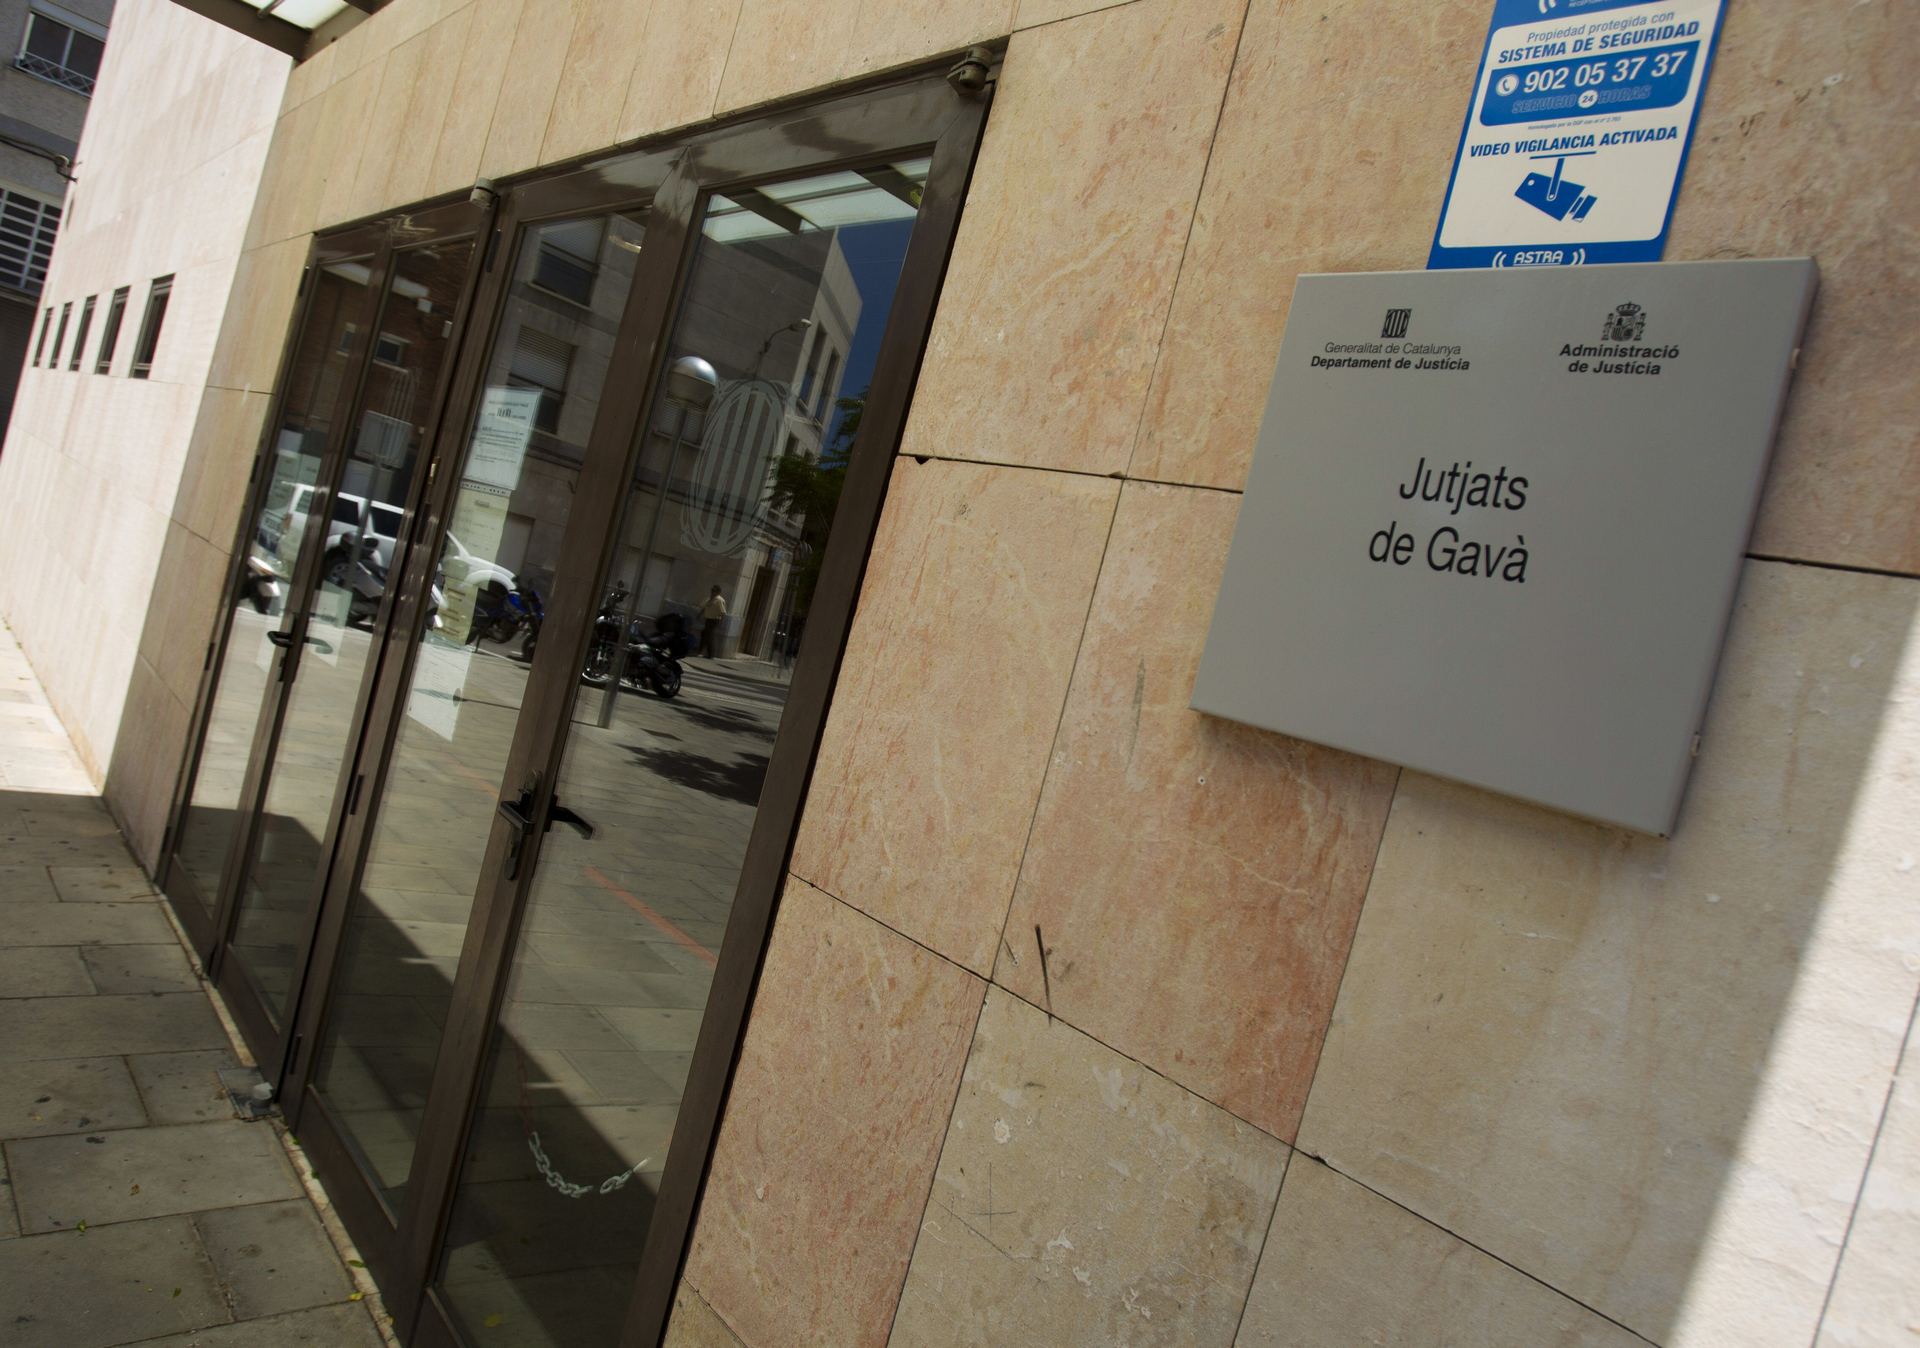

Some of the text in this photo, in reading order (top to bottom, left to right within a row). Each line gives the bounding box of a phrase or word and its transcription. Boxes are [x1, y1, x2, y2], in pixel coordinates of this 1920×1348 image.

[1498, 21, 1700, 63] SISTEMA DE SEGURIDAD
[1527, 12, 1674, 43] Propiedad protegida con
[1523, 50, 1688, 93] 902 05 37 37
[1470, 126, 1678, 157] VIDEO VIGILANCIA ACTIVADA
[1513, 250, 1564, 264] ASTRA
[1311, 356, 1470, 370] Departament de Justícia
[1325, 342, 1461, 357] Generalitat de Catalunya
[1560, 344, 1679, 359] Administració
[1568, 360, 1661, 375] de Justícia
[1400, 457, 1529, 515] Jutjats
[1369, 521, 1529, 583] de Gavà
